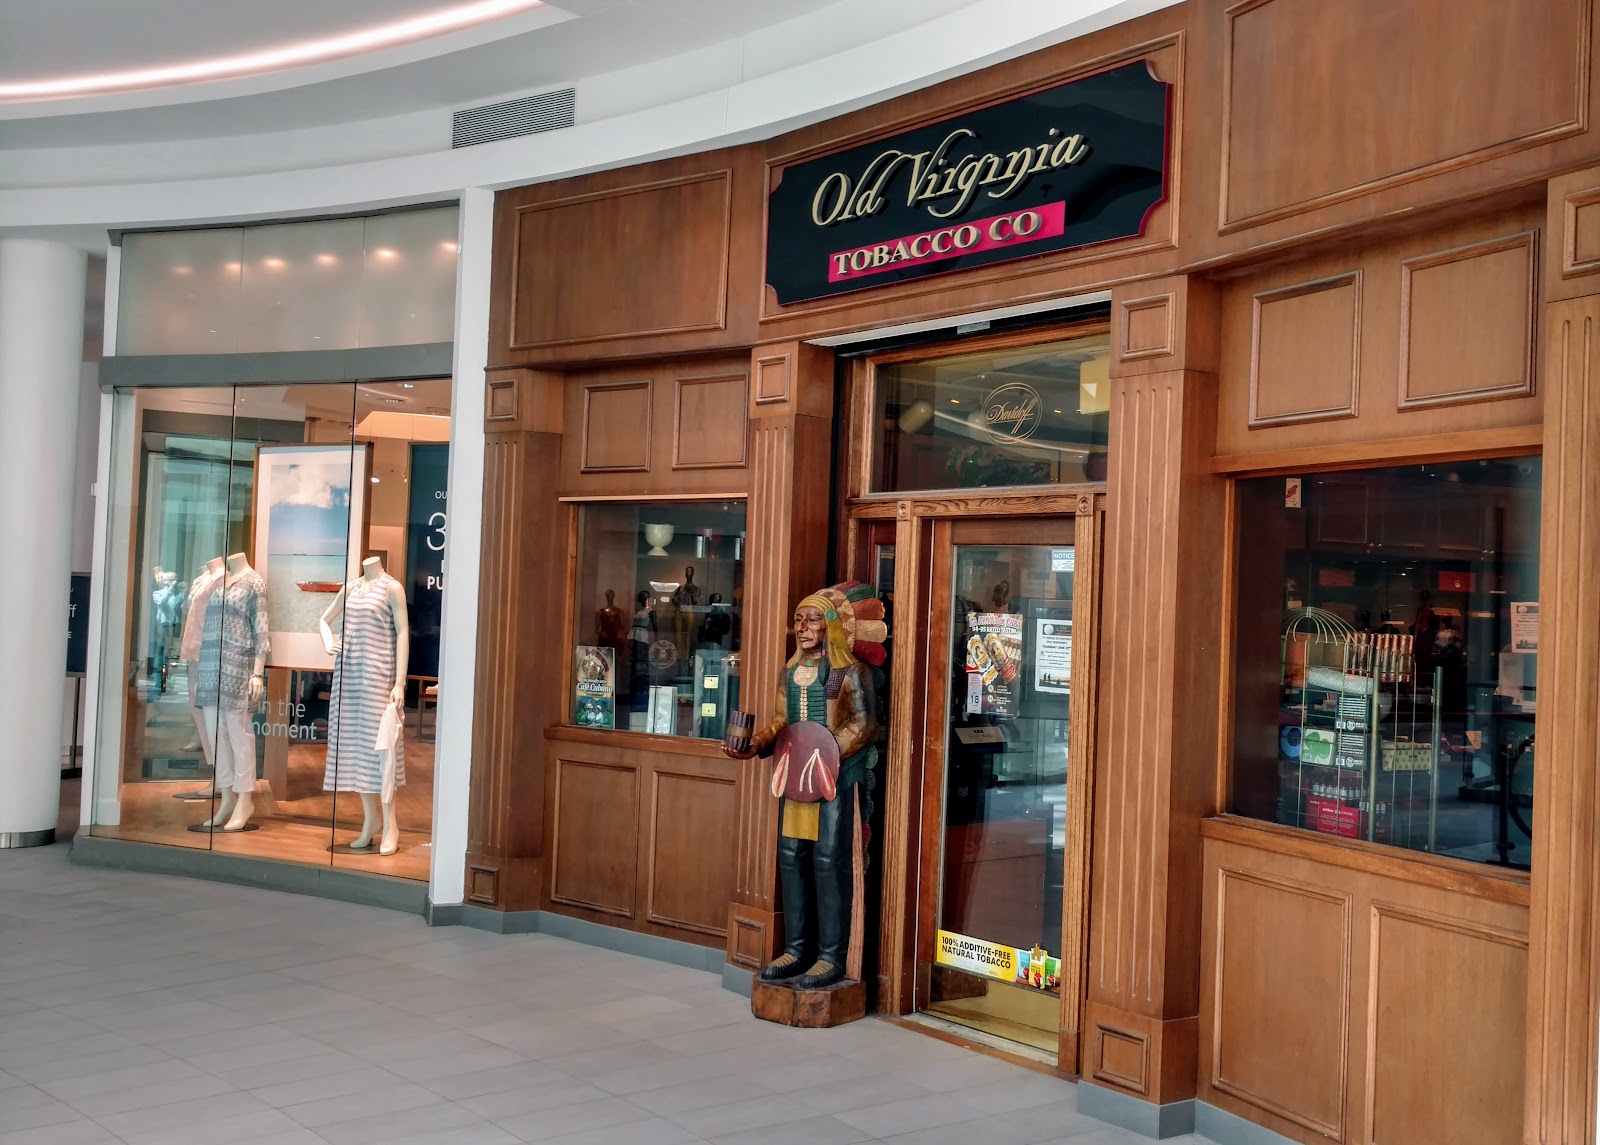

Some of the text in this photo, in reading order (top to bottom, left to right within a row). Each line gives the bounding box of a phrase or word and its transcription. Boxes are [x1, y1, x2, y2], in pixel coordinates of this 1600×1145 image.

[812, 128, 1088, 226] Old Virginia
[834, 211, 1042, 275] TOBACCO CO
[986, 397, 1039, 434] Davidoff
[258, 694, 306, 718] in the
[970, 695, 980, 704] 18
[941, 936, 1011, 961] 100% ADDITIVE-FREE
[941, 946, 974, 959] NATURAL
[976, 953, 1011, 969] TOBACCO
